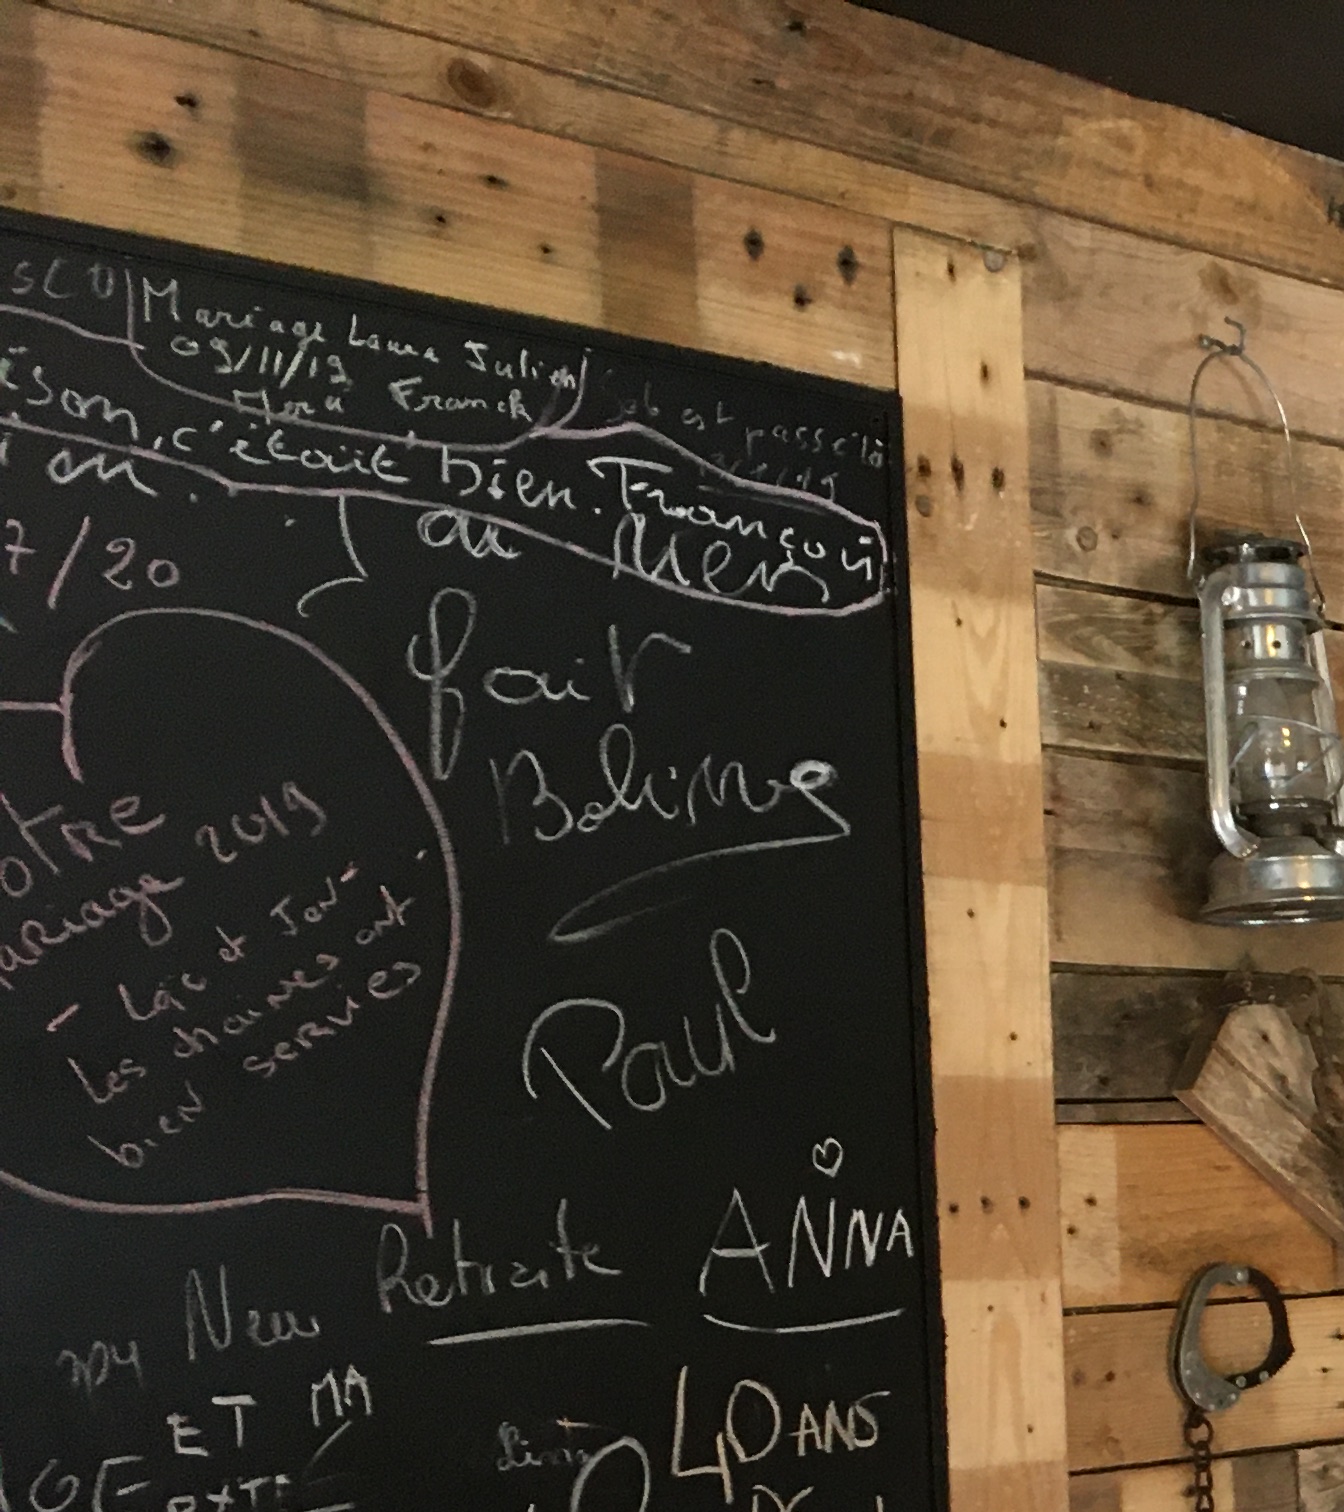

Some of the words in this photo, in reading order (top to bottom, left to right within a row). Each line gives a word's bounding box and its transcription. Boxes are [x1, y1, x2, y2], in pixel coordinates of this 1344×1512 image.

[142, 276, 326, 352] Mariage
[388, 375, 533, 422] Franck
[522, 927, 776, 1130] Paul
[698, 1187, 914, 1294] ANNA
